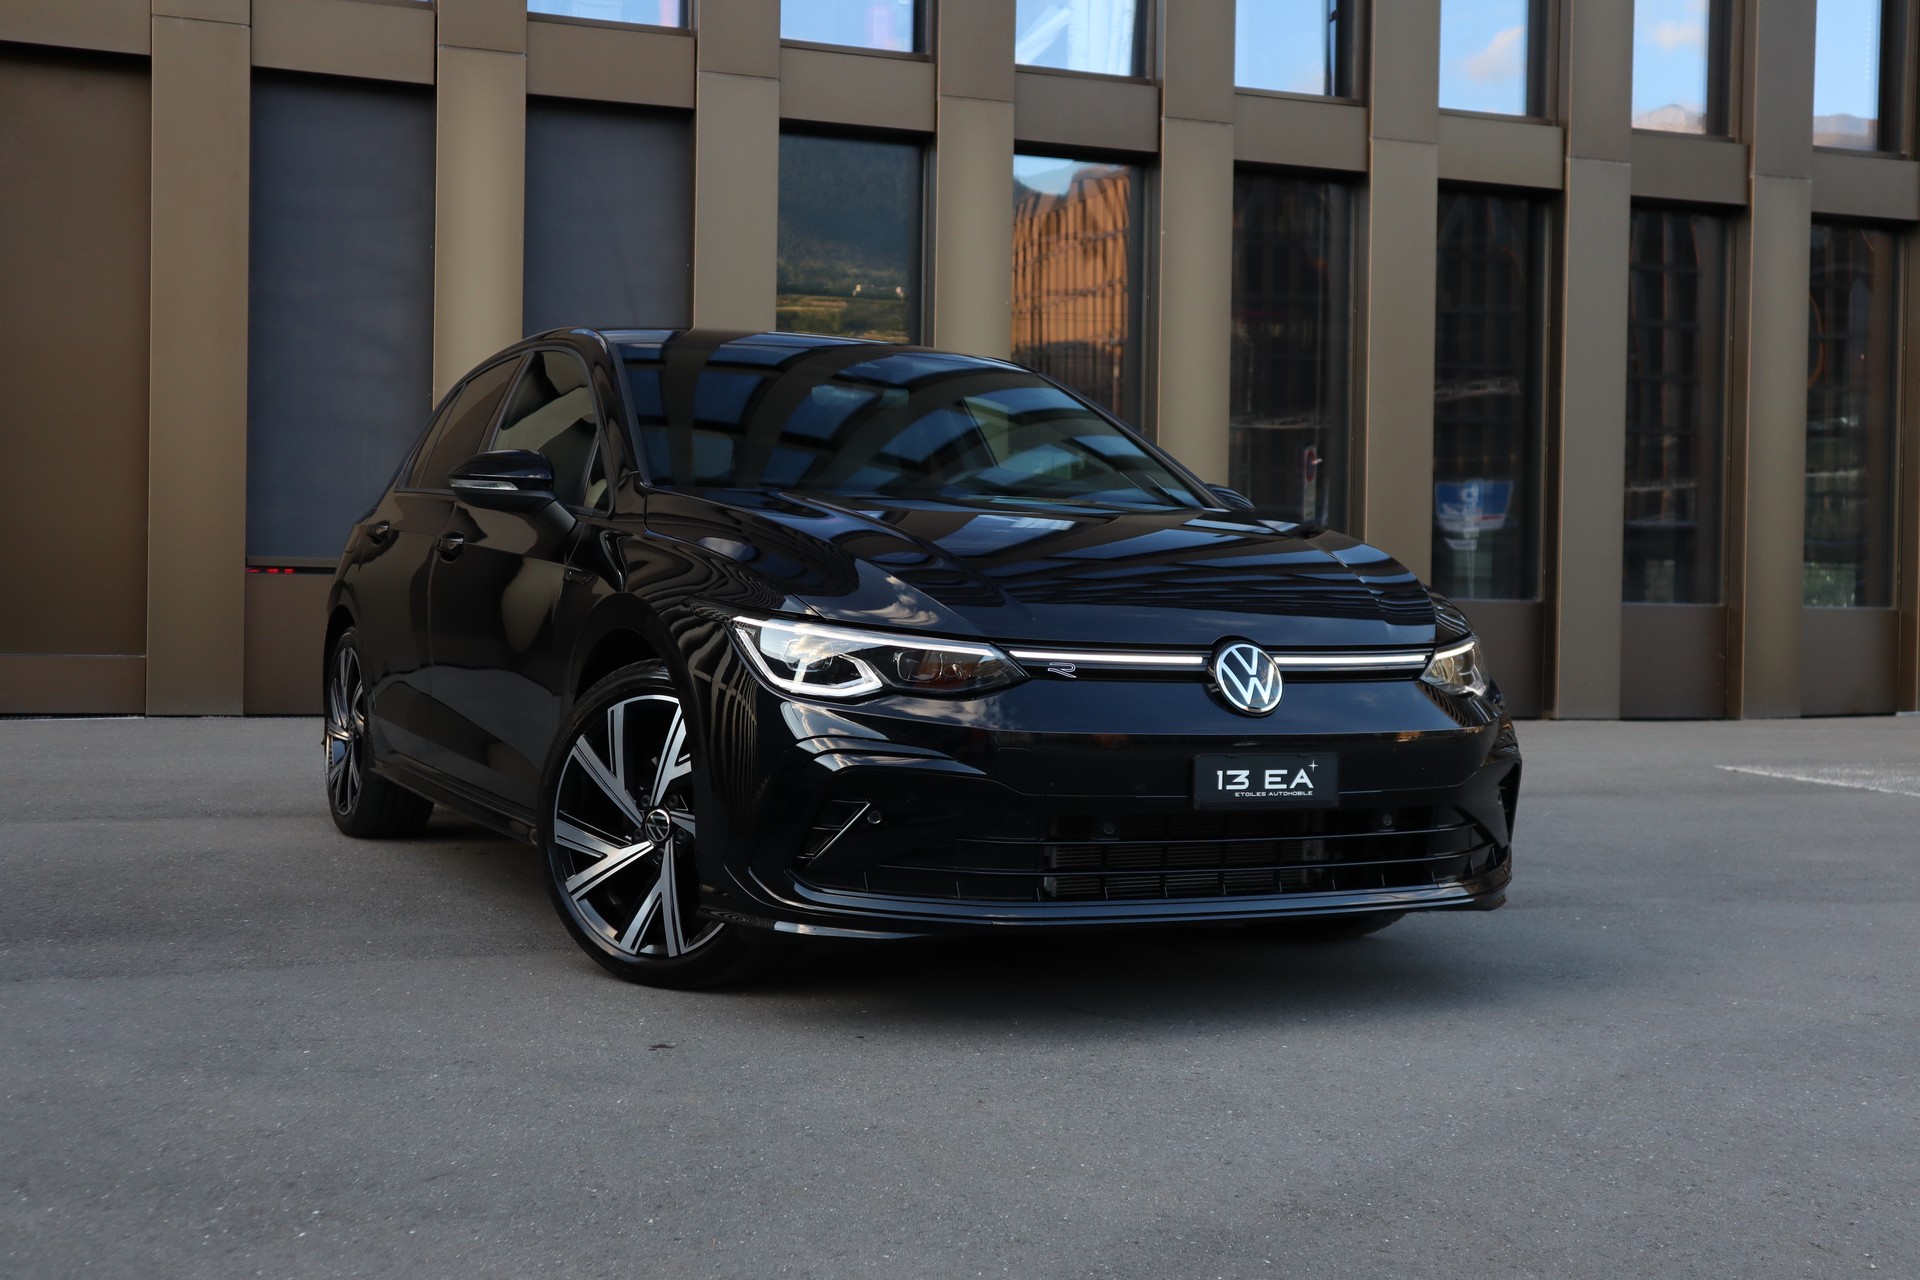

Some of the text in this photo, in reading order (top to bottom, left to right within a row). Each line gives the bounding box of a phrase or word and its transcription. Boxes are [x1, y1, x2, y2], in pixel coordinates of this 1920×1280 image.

[1215, 643, 1283, 714] VW
[1216, 767, 1315, 791] 13 EA
